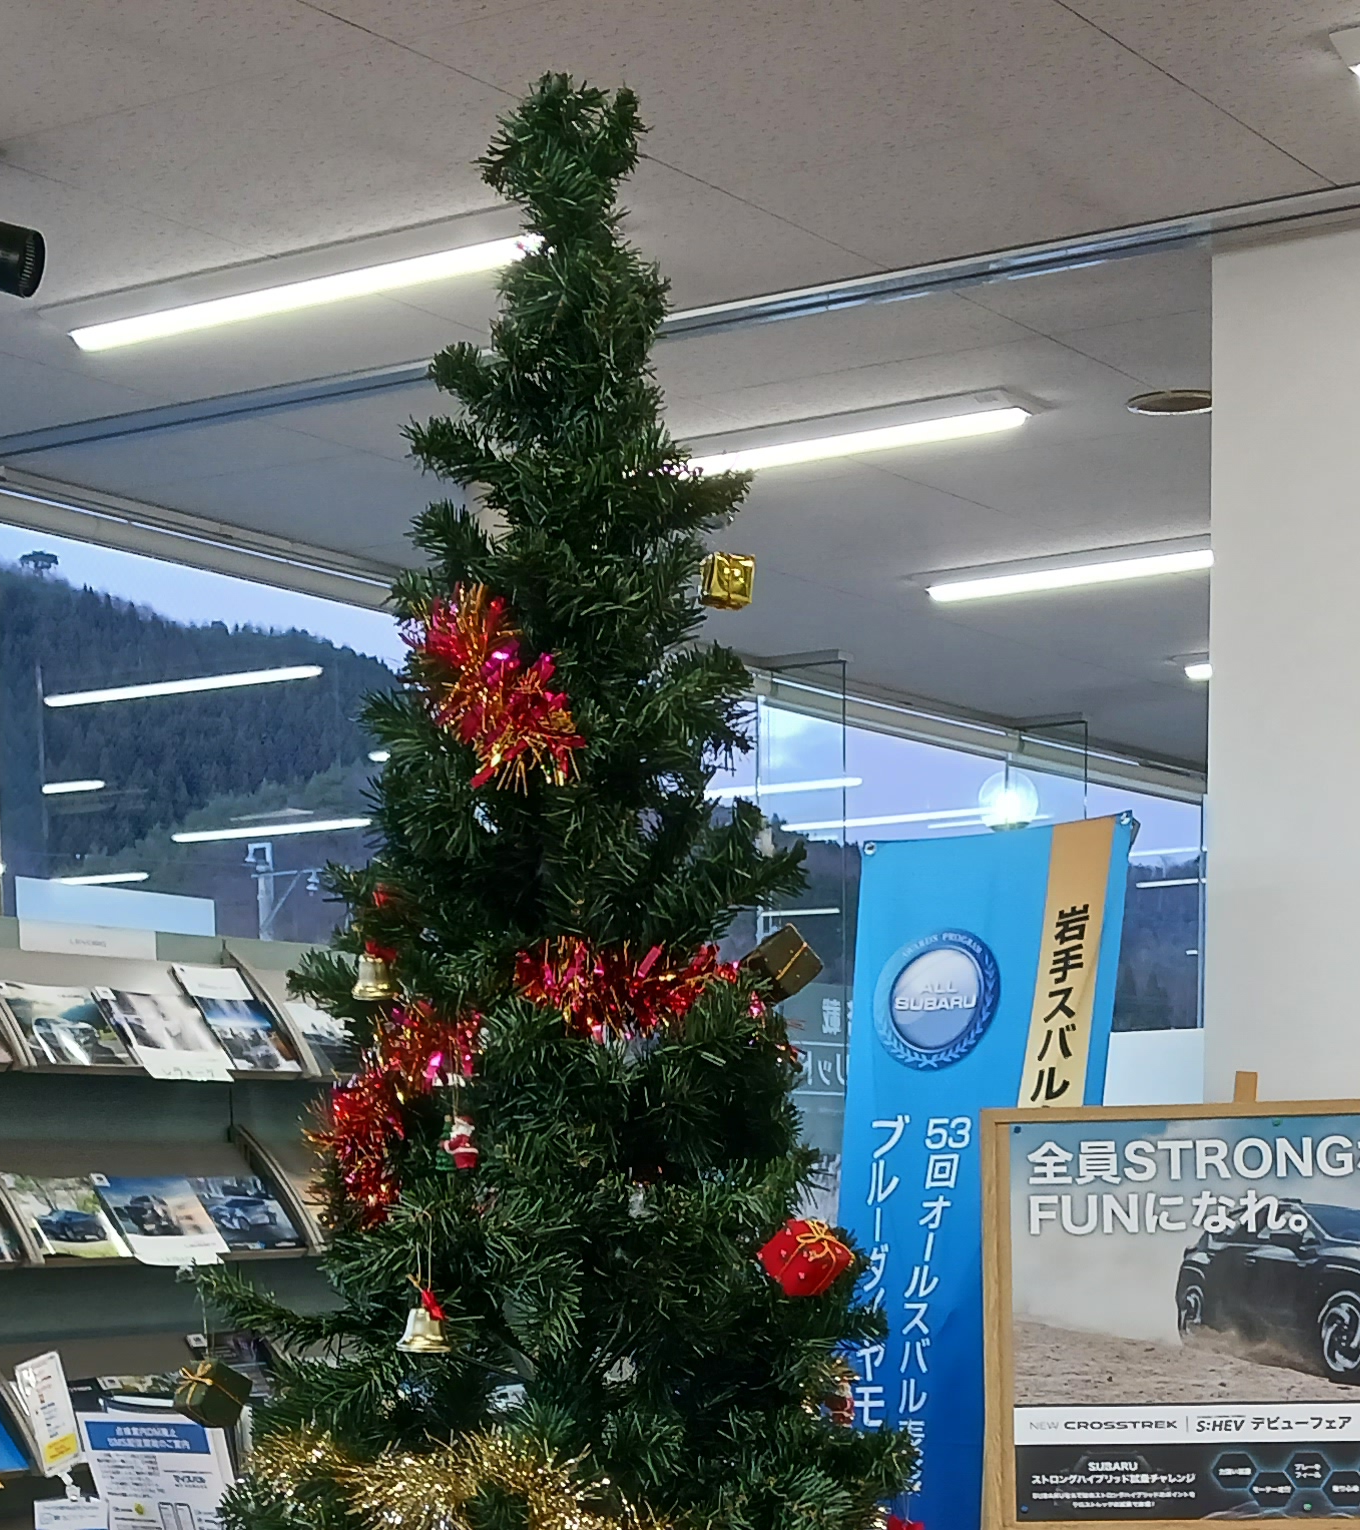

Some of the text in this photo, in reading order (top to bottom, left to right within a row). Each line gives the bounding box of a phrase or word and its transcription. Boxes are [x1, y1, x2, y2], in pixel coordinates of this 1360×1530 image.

[921, 980, 957, 994] ALL
[894, 994, 976, 1011] SUBARU
[1030, 903, 1090, 1103] 岩手スバル
[1027, 1191, 1310, 1236] FUNになれ。
[1029, 1421, 1059, 1430] NEW
[1064, 1419, 1178, 1430] CROSSTREK
[1196, 1416, 1245, 1432] S:HEV
[1251, 1416, 1352, 1431] デビューフェア
[1088, 1461, 1138, 1472] SUBARU
